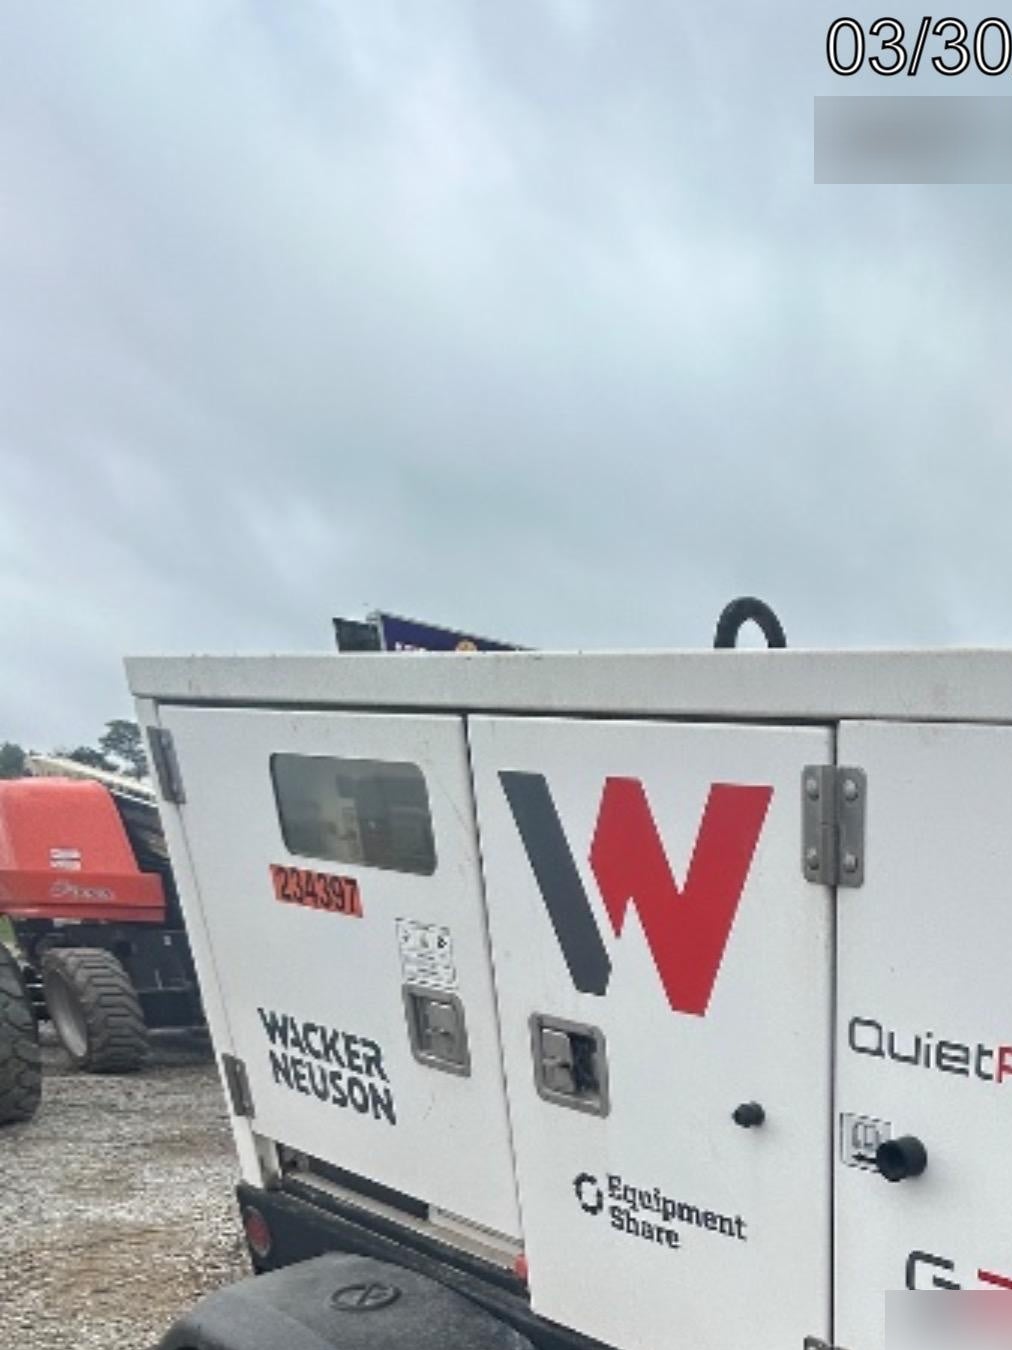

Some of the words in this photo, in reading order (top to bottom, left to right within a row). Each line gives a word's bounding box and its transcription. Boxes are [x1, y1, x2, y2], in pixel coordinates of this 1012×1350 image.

[274, 865, 359, 913] 234397
[257, 1006, 391, 1084] WACKER
[269, 1049, 397, 1126] NEUSON
[606, 1173, 748, 1242] Equipment
[608, 1204, 681, 1250] Share
